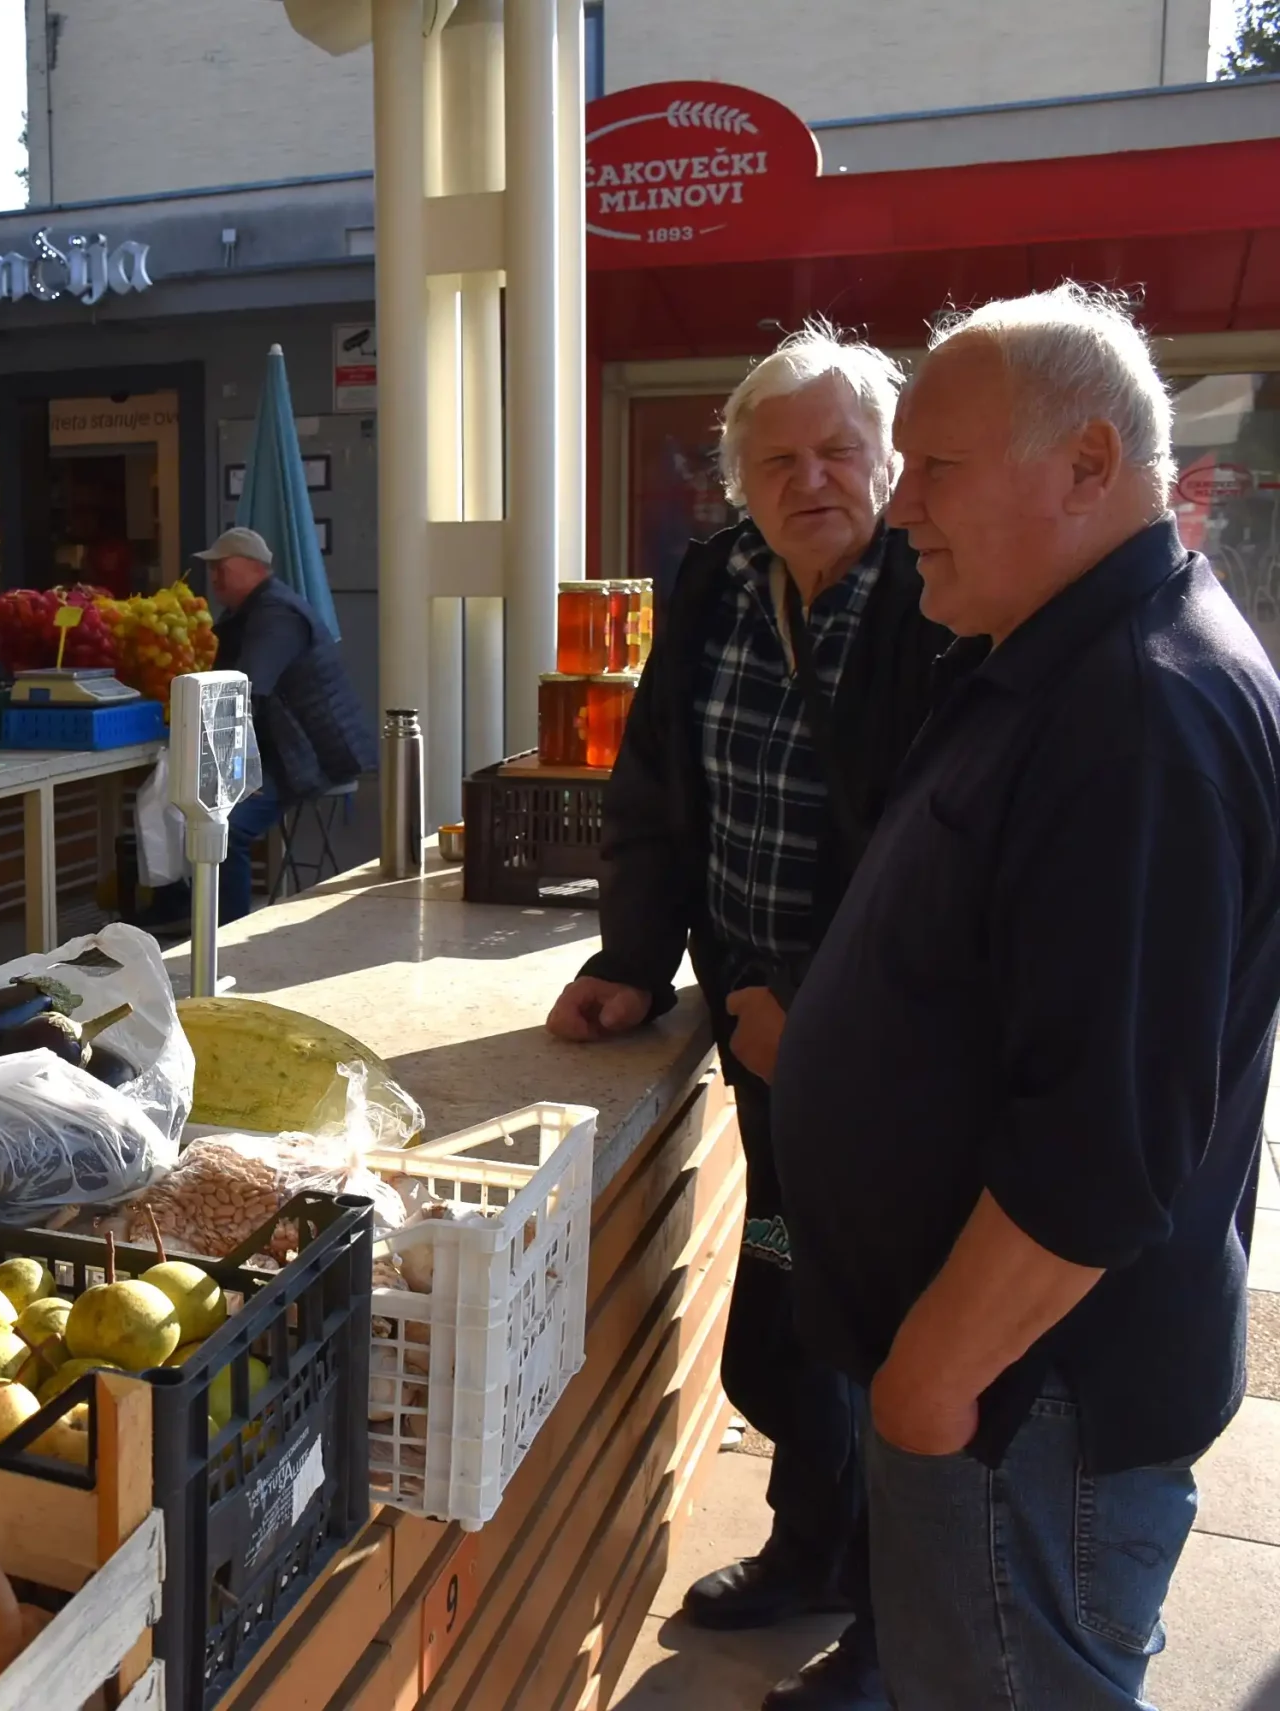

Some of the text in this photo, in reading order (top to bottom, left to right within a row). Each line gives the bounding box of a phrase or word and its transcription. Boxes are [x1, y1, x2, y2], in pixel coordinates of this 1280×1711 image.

[599, 182, 743, 214] MLINOVI
[647, 226, 693, 243] 1893
[447, 1573, 459, 1634] 9
